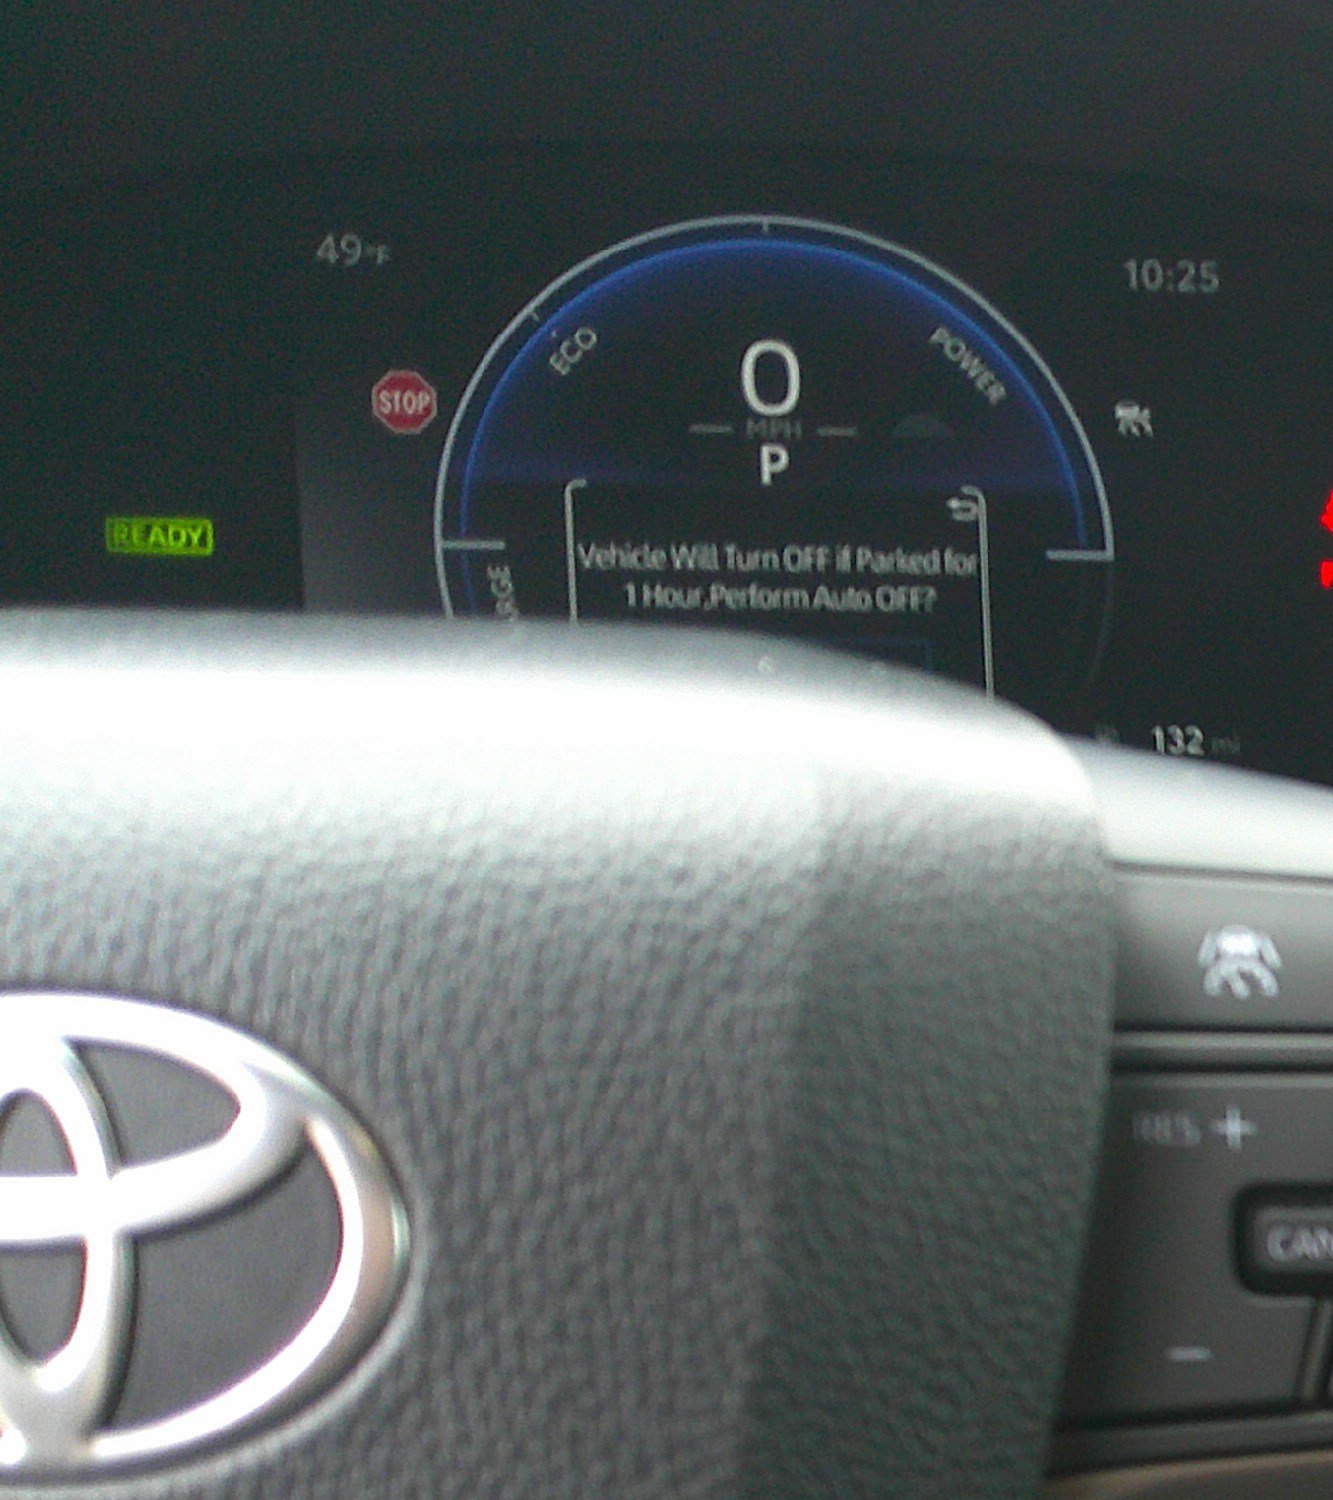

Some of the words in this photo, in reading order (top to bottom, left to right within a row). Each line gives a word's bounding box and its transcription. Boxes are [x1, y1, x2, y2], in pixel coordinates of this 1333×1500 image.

[1123, 258, 1219, 293] 10:25
[549, 326, 597, 375] ECO
[929, 327, 1007, 405] POWER
[378, 388, 431, 416] STOP
[761, 443, 790, 485] P
[113, 522, 205, 550] READY
[578, 543, 668, 571] Vehicle
[670, 544, 718, 571] Will
[726, 545, 780, 573] Turn
[784, 547, 831, 573] OFF
[834, 547, 851, 573] if
[856, 548, 941, 575] Parked
[943, 550, 977, 576] for
[625, 584, 637, 607] 1
[812, 586, 870, 612] Auto
[874, 587, 937, 613] OFF?
[1150, 724, 1205, 755] 132
